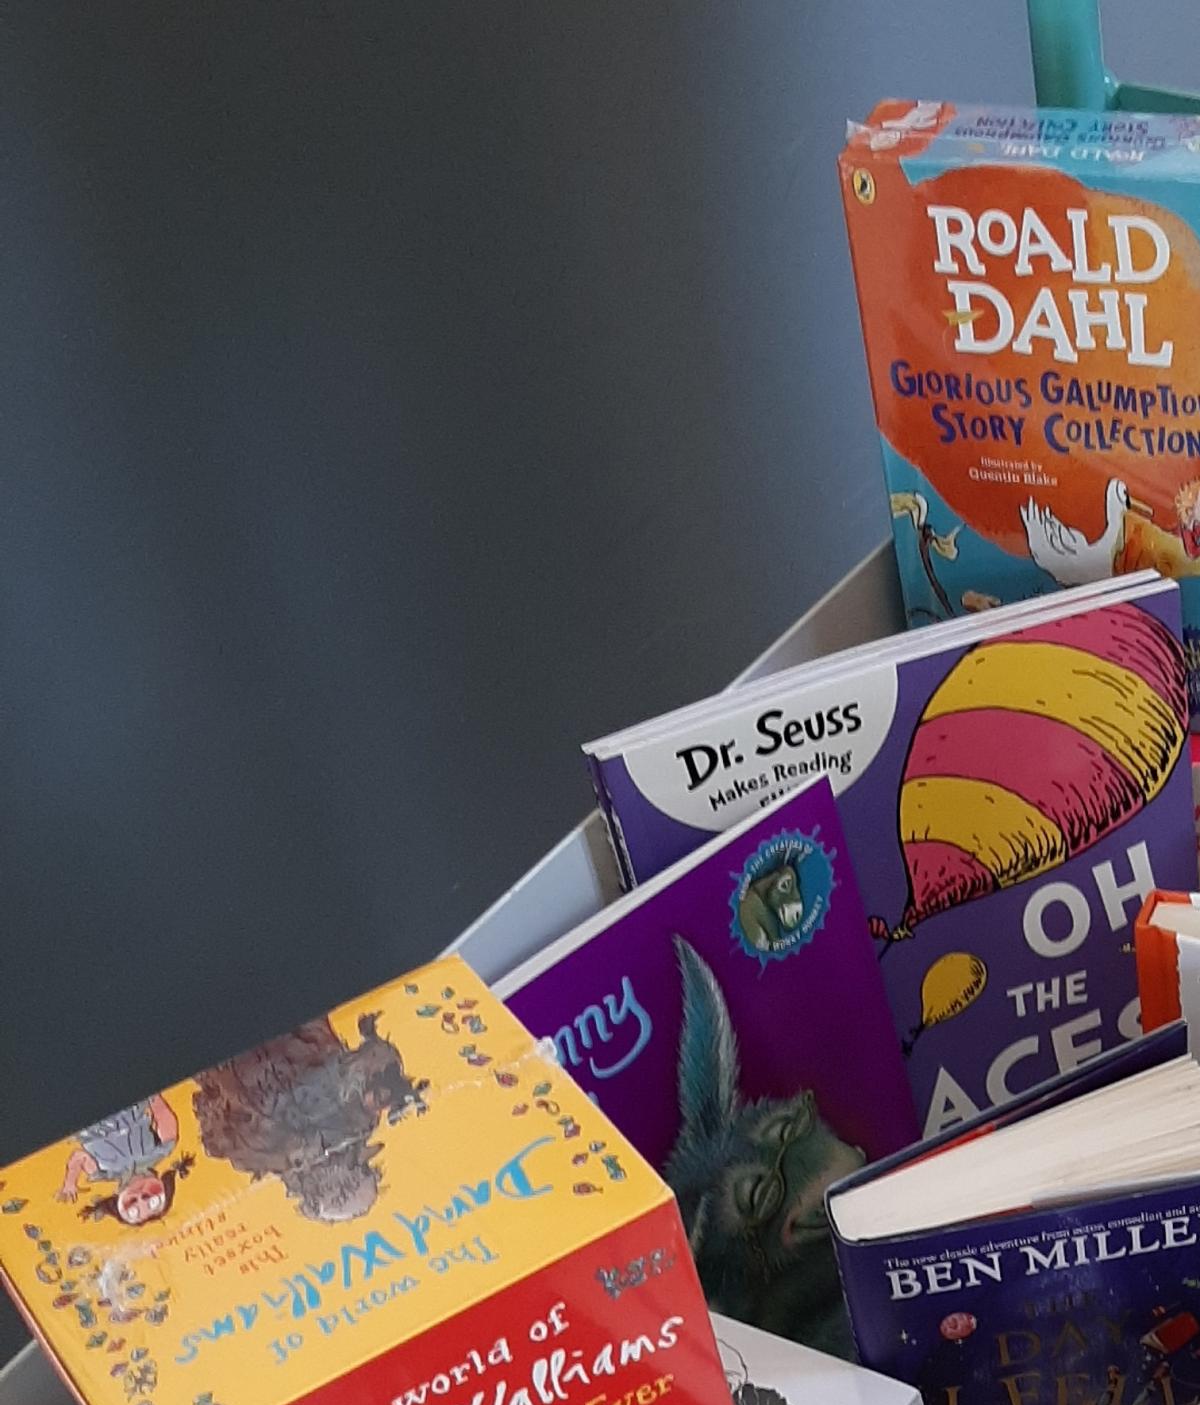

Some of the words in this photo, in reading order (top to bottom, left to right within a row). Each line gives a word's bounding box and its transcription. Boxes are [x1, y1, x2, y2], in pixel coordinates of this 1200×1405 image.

[927, 205, 1171, 284] ROALD
[947, 280, 1174, 368] DAHL
[890, 361, 1032, 409] GLORIOUS
[932, 404, 1025, 446] STORY
[1023, 470, 1058, 487] Blake
[676, 741, 744, 791] Dr.
[756, 702, 862, 756] Seuss
[709, 775, 769, 812] Makes
[772, 748, 853, 783] Reading
[1022, 840, 1159, 958] OH
[1007, 969, 1089, 1018] THE
[394, 1135, 556, 1256] David
[182, 1224, 249, 1262] really
[201, 1224, 284, 1278] boxset
[238, 1241, 290, 1276] This
[428, 1236, 499, 1279] The
[884, 1256, 911, 1271] The
[912, 1254, 937, 1267] new
[939, 1245, 978, 1263] classic
[980, 1235, 1040, 1255] adventure
[1041, 1227, 1071, 1243] from
[1107, 1211, 1163, 1230] comedian
[1165, 1205, 1188, 1219] and
[174, 1229, 404, 1364] Walliams
[885, 1250, 1003, 1301] BEN
[315, 1275, 419, 1335] world
[529, 1302, 570, 1344] of
[263, 1331, 304, 1366] of
